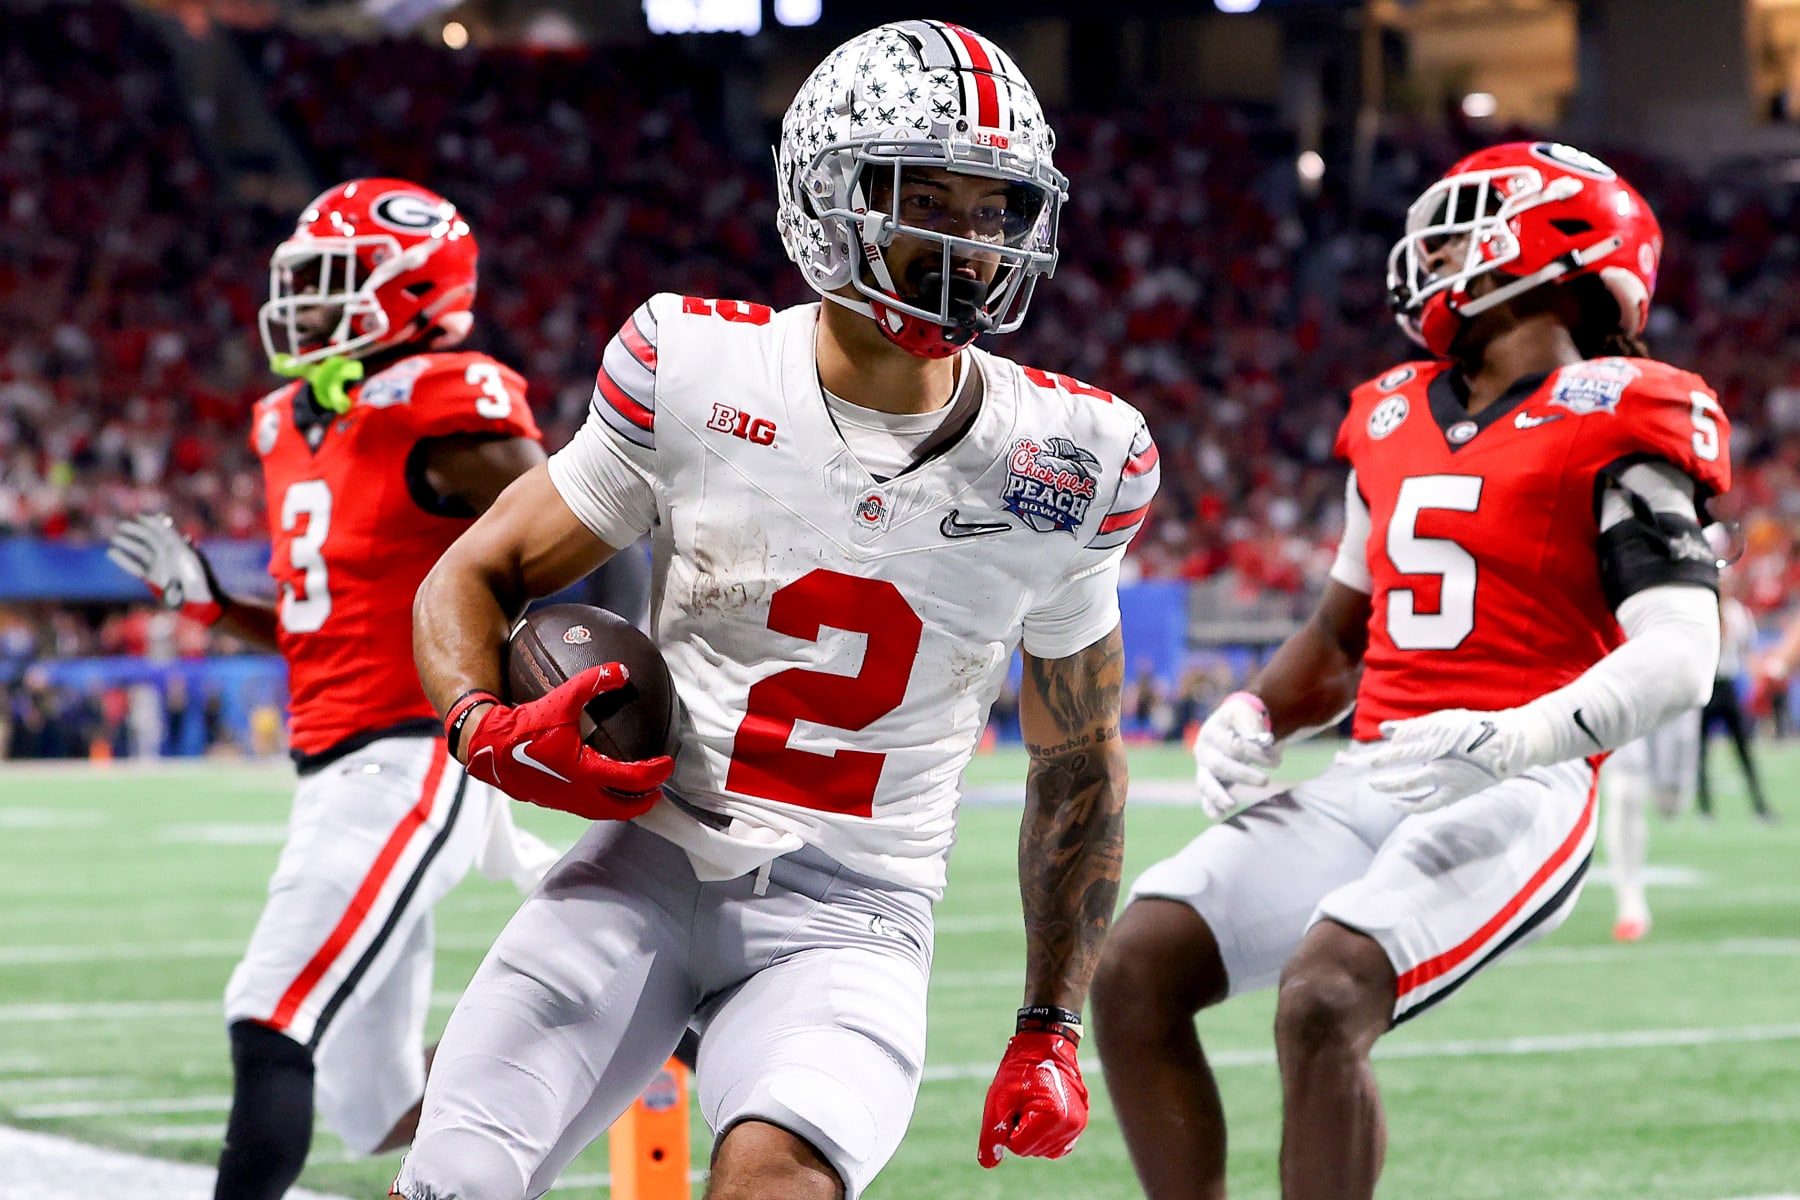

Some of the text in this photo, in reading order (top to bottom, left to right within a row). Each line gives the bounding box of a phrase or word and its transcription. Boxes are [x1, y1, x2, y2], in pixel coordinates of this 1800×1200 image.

[465, 361, 513, 419] 3
[1689, 391, 1722, 462] 5
[1005, 475, 1089, 523] PEACH
[1018, 501, 1065, 524] BOWL
[280, 479, 333, 634] 3
[1386, 475, 1483, 650] 5
[726, 569, 922, 818] 2
